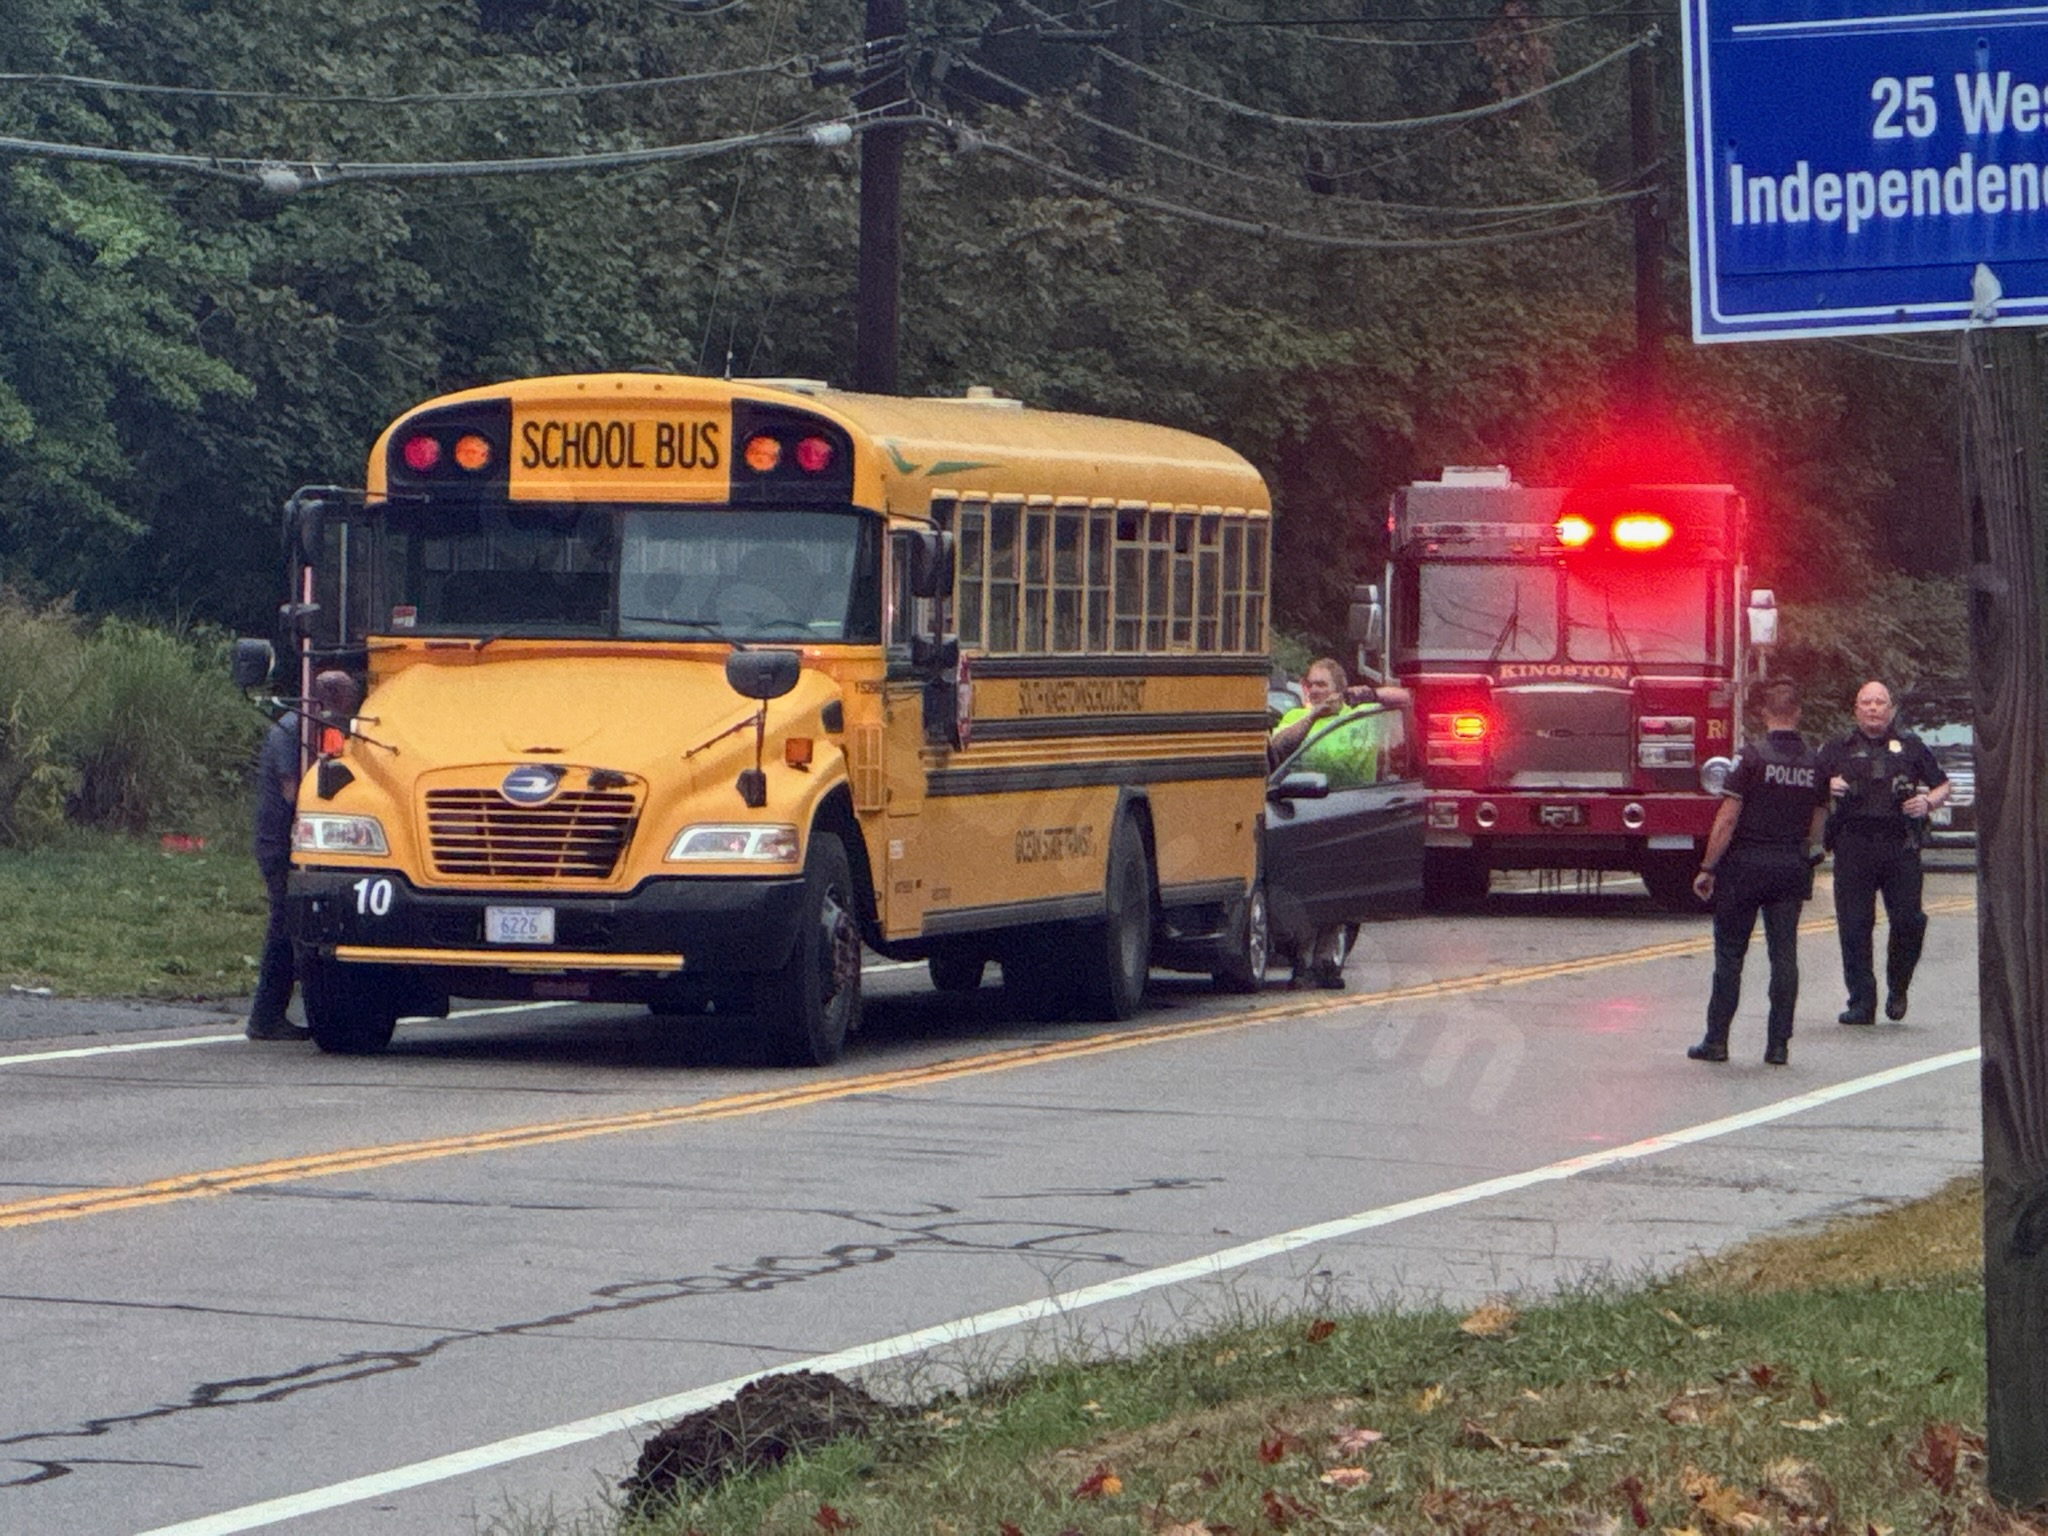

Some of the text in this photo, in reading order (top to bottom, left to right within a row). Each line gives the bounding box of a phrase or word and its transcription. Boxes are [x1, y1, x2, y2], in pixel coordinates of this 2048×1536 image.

[1870, 70, 2048, 140] 25 We
[1729, 151, 2048, 234] Independen
[521, 420, 720, 469] SCHOOL BUS
[1500, 663, 1630, 679] KINGSTON
[1764, 764, 1816, 788] POLICE
[353, 878, 393, 916] 10
[500, 917, 538, 935] 6226
